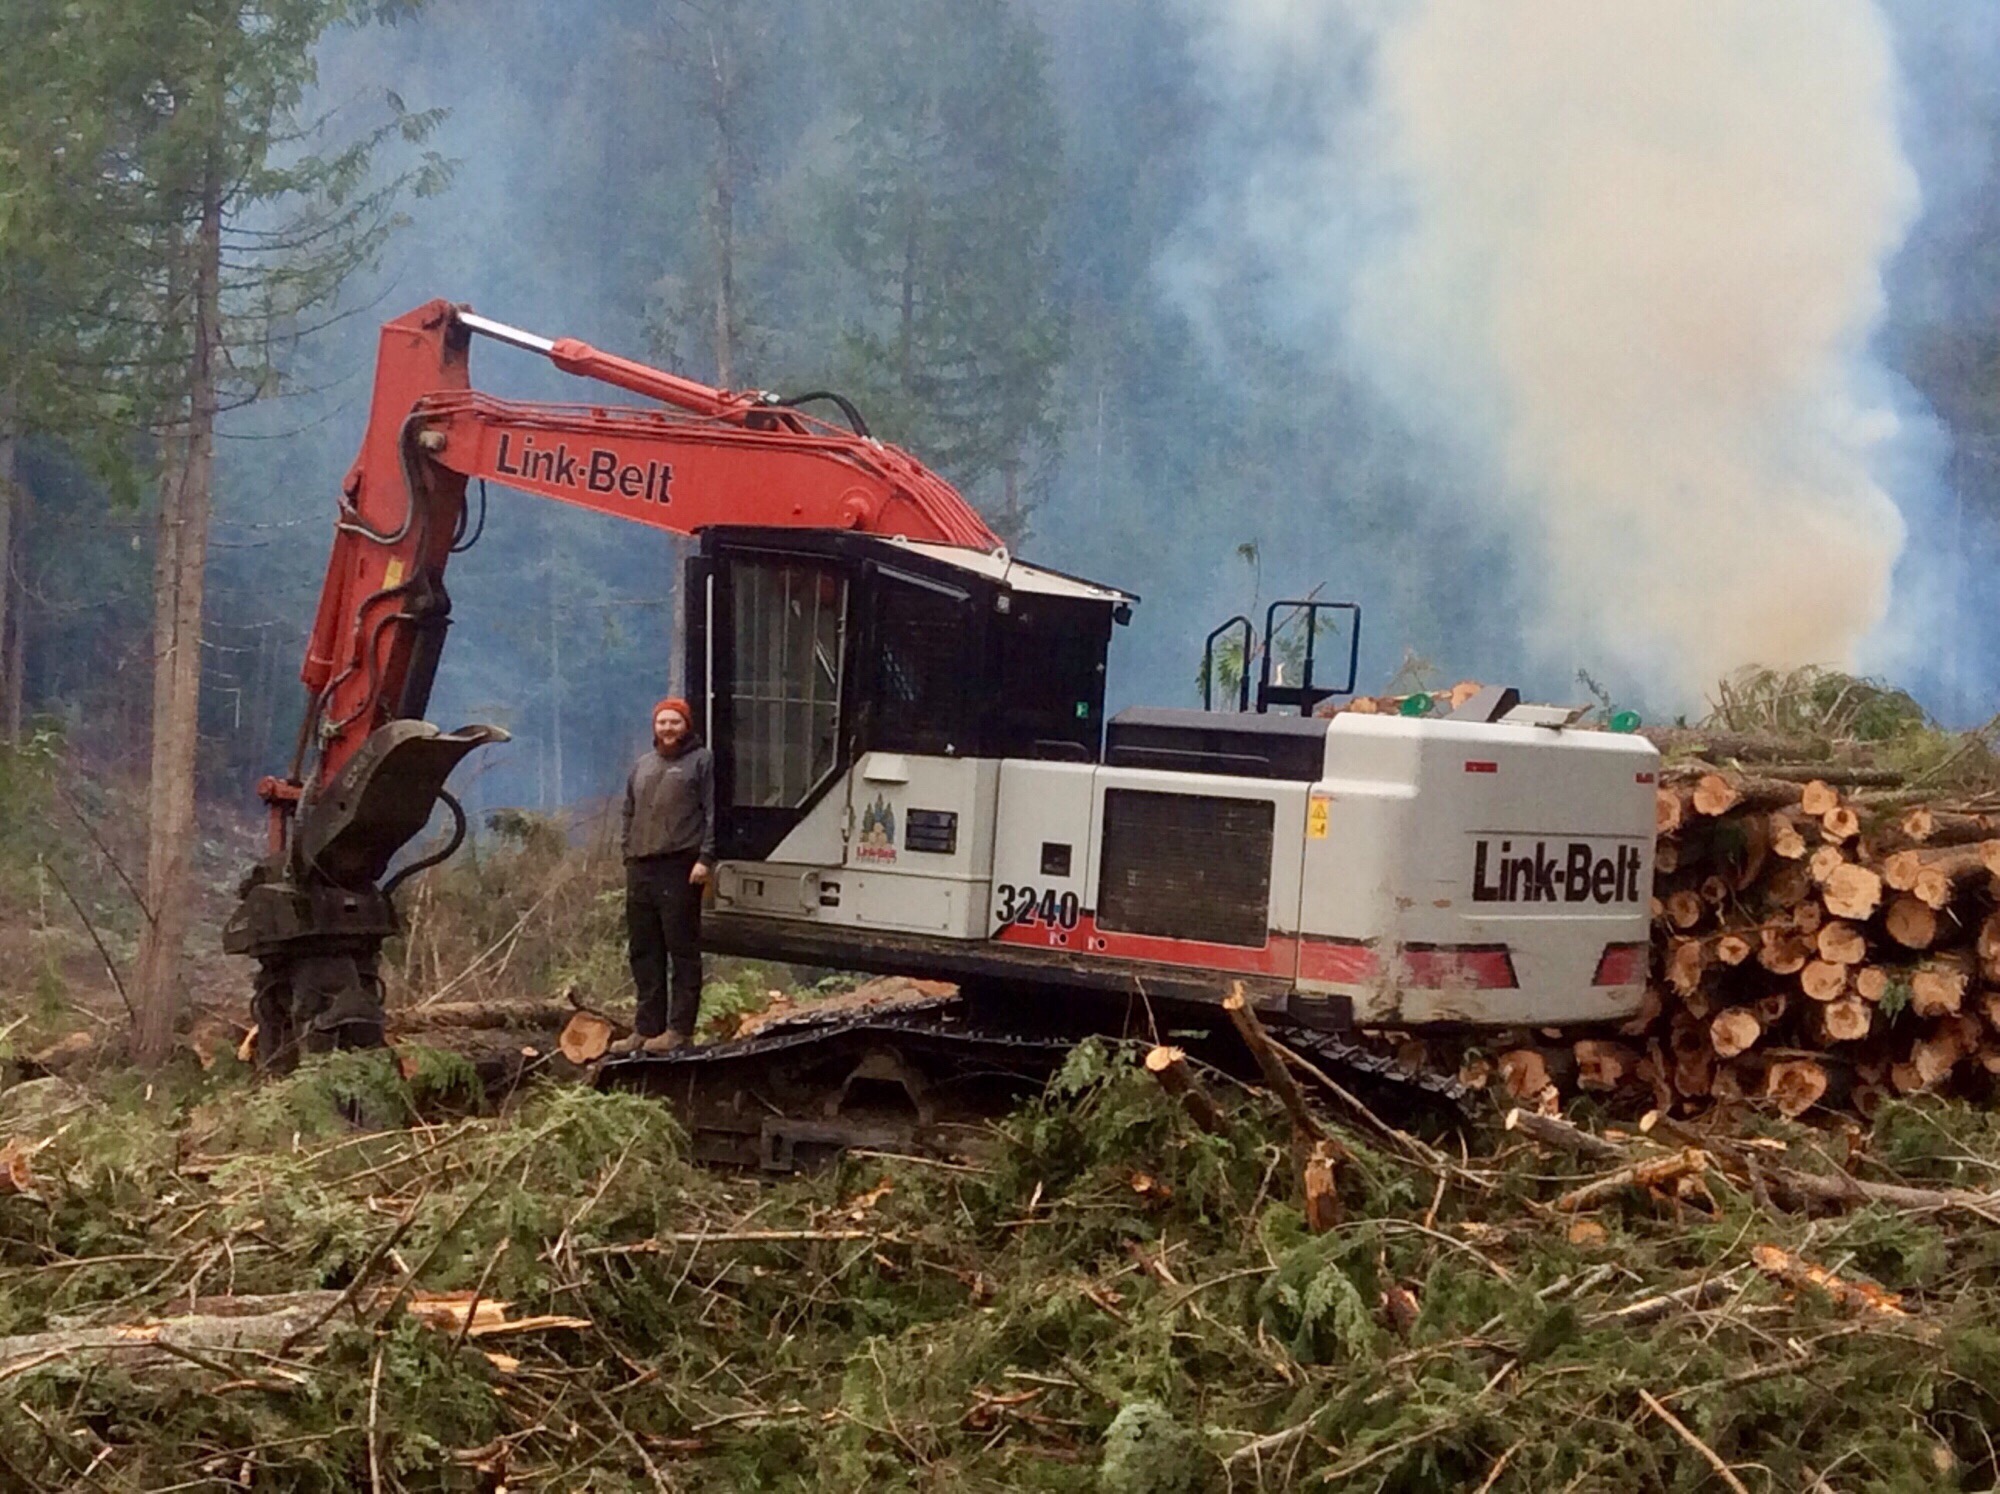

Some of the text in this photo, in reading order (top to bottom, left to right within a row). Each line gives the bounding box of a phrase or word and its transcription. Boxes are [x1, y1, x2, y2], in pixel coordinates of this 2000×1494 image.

[496, 434, 673, 503] Link-Belt
[1472, 840, 1642, 904] Link-Belt
[996, 884, 1079, 929] 3240
